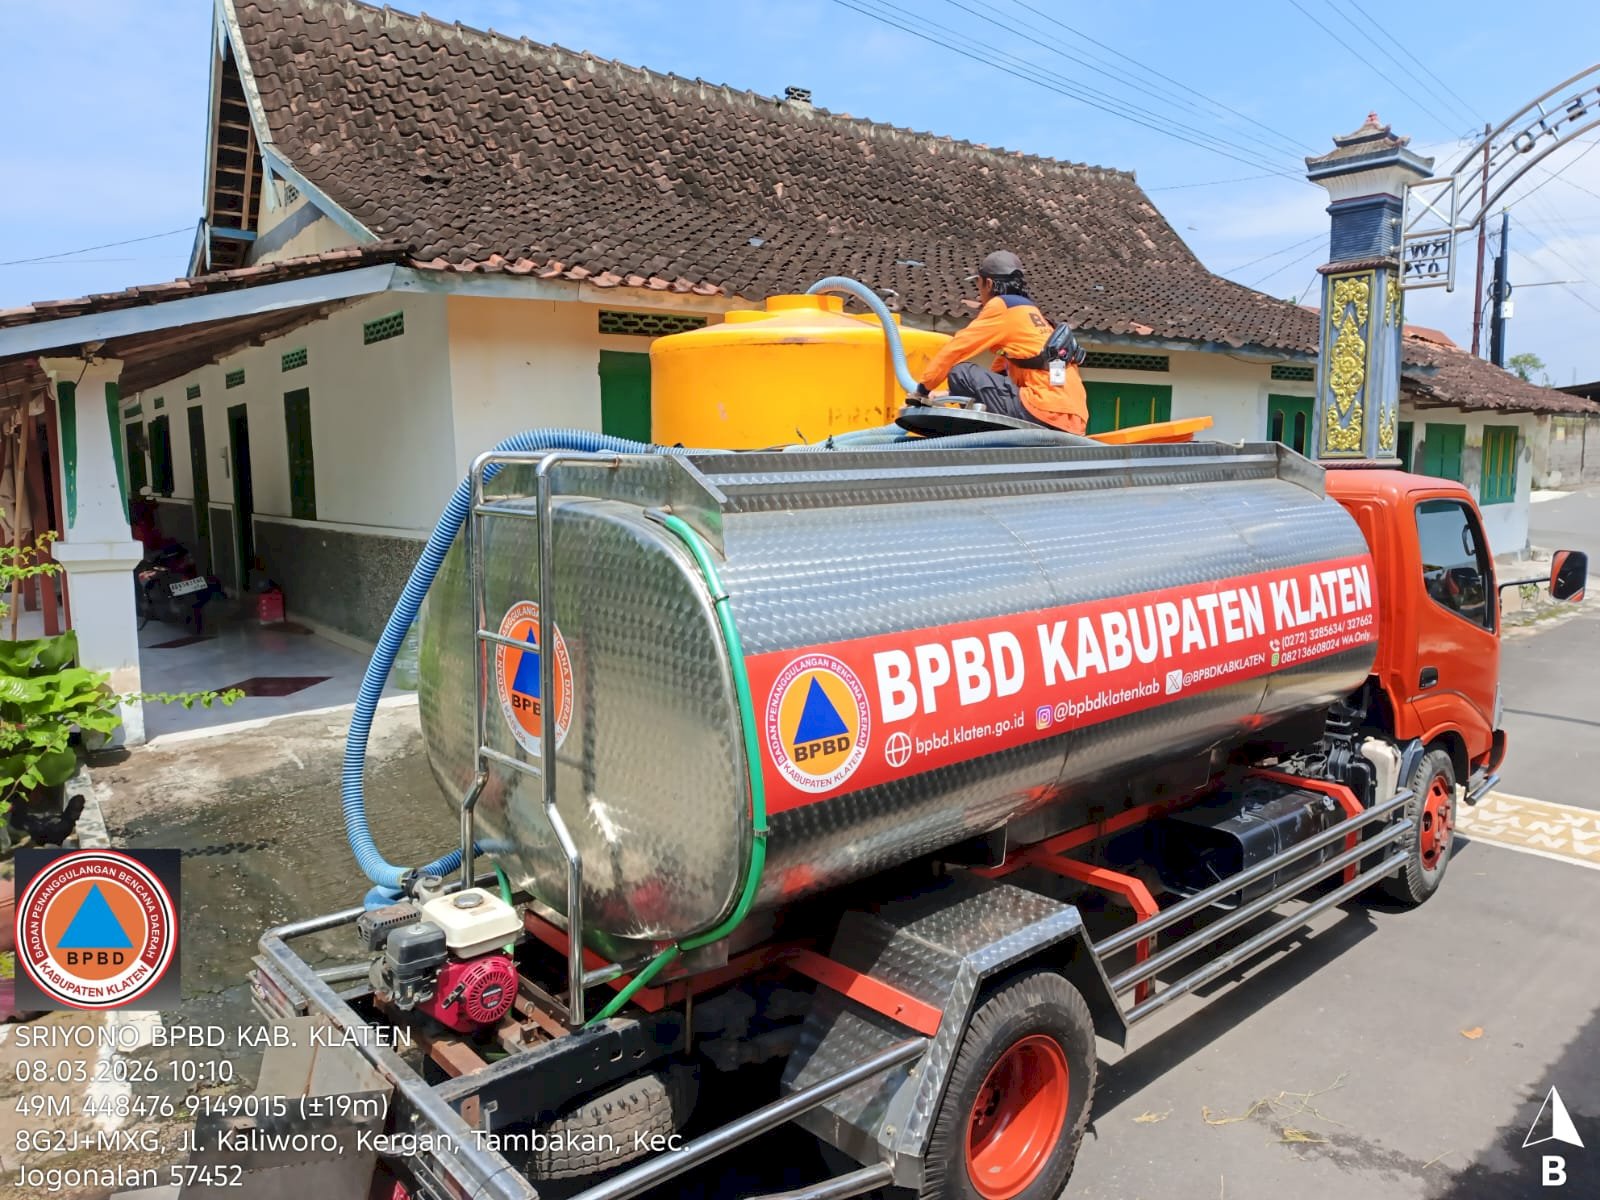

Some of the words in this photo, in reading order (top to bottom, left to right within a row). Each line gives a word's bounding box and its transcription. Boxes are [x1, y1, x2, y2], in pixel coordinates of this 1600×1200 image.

[873, 631, 1025, 724] BPBD
[1037, 585, 1266, 687] KABUPATEN
[1269, 564, 1372, 631] KLATEN
[1282, 631, 1308, 651] (0272)
[1309, 620, 1345, 641] 3285634/
[1347, 614, 1373, 630] 327662
[830, 661, 862, 701] BENCANA
[1183, 653, 1265, 687] @BPBDKABKLATEN
[512, 694, 541, 716] BPB
[769, 658, 830, 722] PENANGGULANGAN
[1054, 677, 1160, 722] @bpbdklatenkab
[770, 725, 786, 763] BADAN
[857, 702, 868, 748] DAERAH
[915, 711, 1025, 754] bpbd.klaten.go.id
[783, 763, 832, 788] KABUPATEN
[833, 749, 862, 783] KLATEN
[794, 736, 850, 763] BPBD
